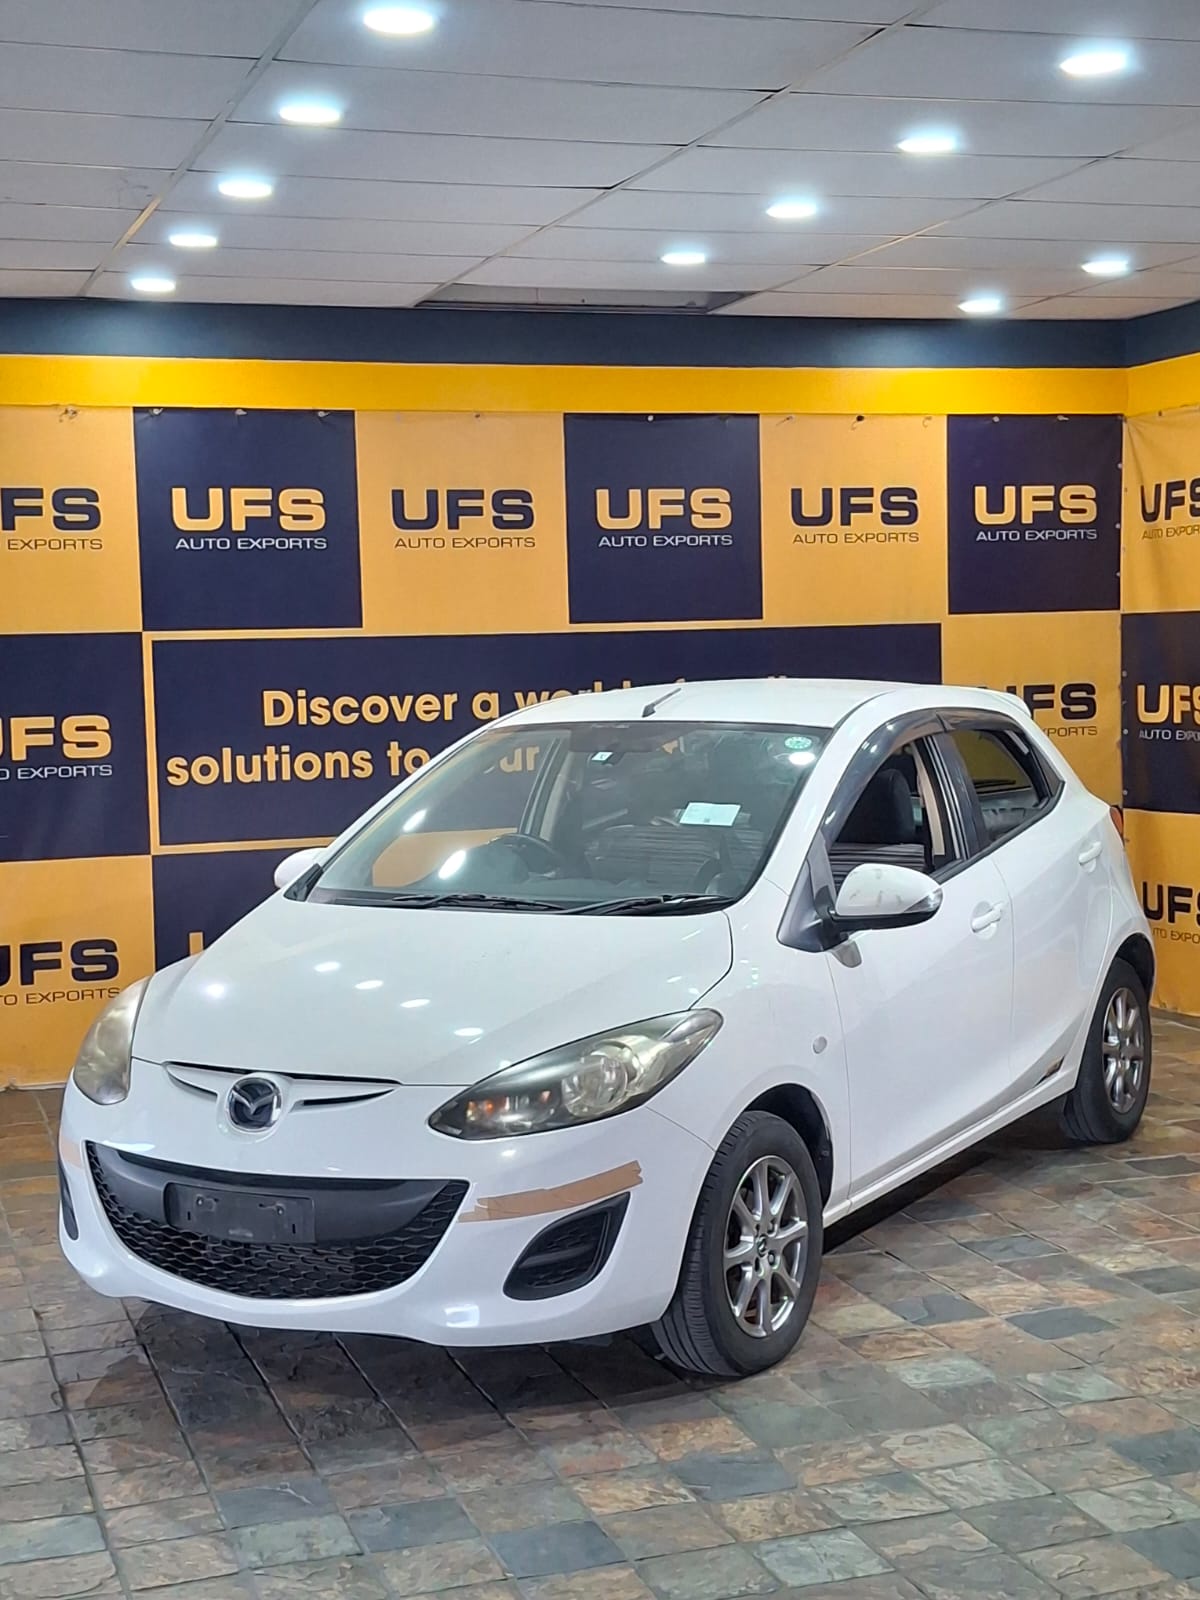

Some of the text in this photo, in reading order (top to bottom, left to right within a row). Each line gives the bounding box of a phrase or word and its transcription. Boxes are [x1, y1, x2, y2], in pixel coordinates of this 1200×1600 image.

[1, 487, 101, 531] FS
[171, 487, 326, 531] UFS
[391, 488, 534, 530] UFS
[595, 488, 733, 530] UFS
[790, 487, 919, 527] UFS
[974, 484, 1098, 525] UFS
[7, 538, 103, 551] EXPORTS
[175, 537, 327, 550] AUTO EXPORTS
[394, 536, 536, 549] AUTO EXPORTS
[598, 534, 733, 548] AUTO EXPORTS
[792, 530, 920, 545] AUTO EXPORTS
[976, 528, 1098, 542] AUTO EXPORTS
[1166, 524, 1200, 538] EXPOR
[262, 689, 458, 727] Discover
[472, 691, 499, 720] a
[0, 714, 112, 761] FS
[17, 764, 113, 780] EXPORTS
[167, 744, 374, 787] solutions
[387, 741, 430, 777] to
[1142, 881, 1200, 926] UF
[0, 938, 119, 988] FS
[26, 987, 120, 1005] EXPORTS
